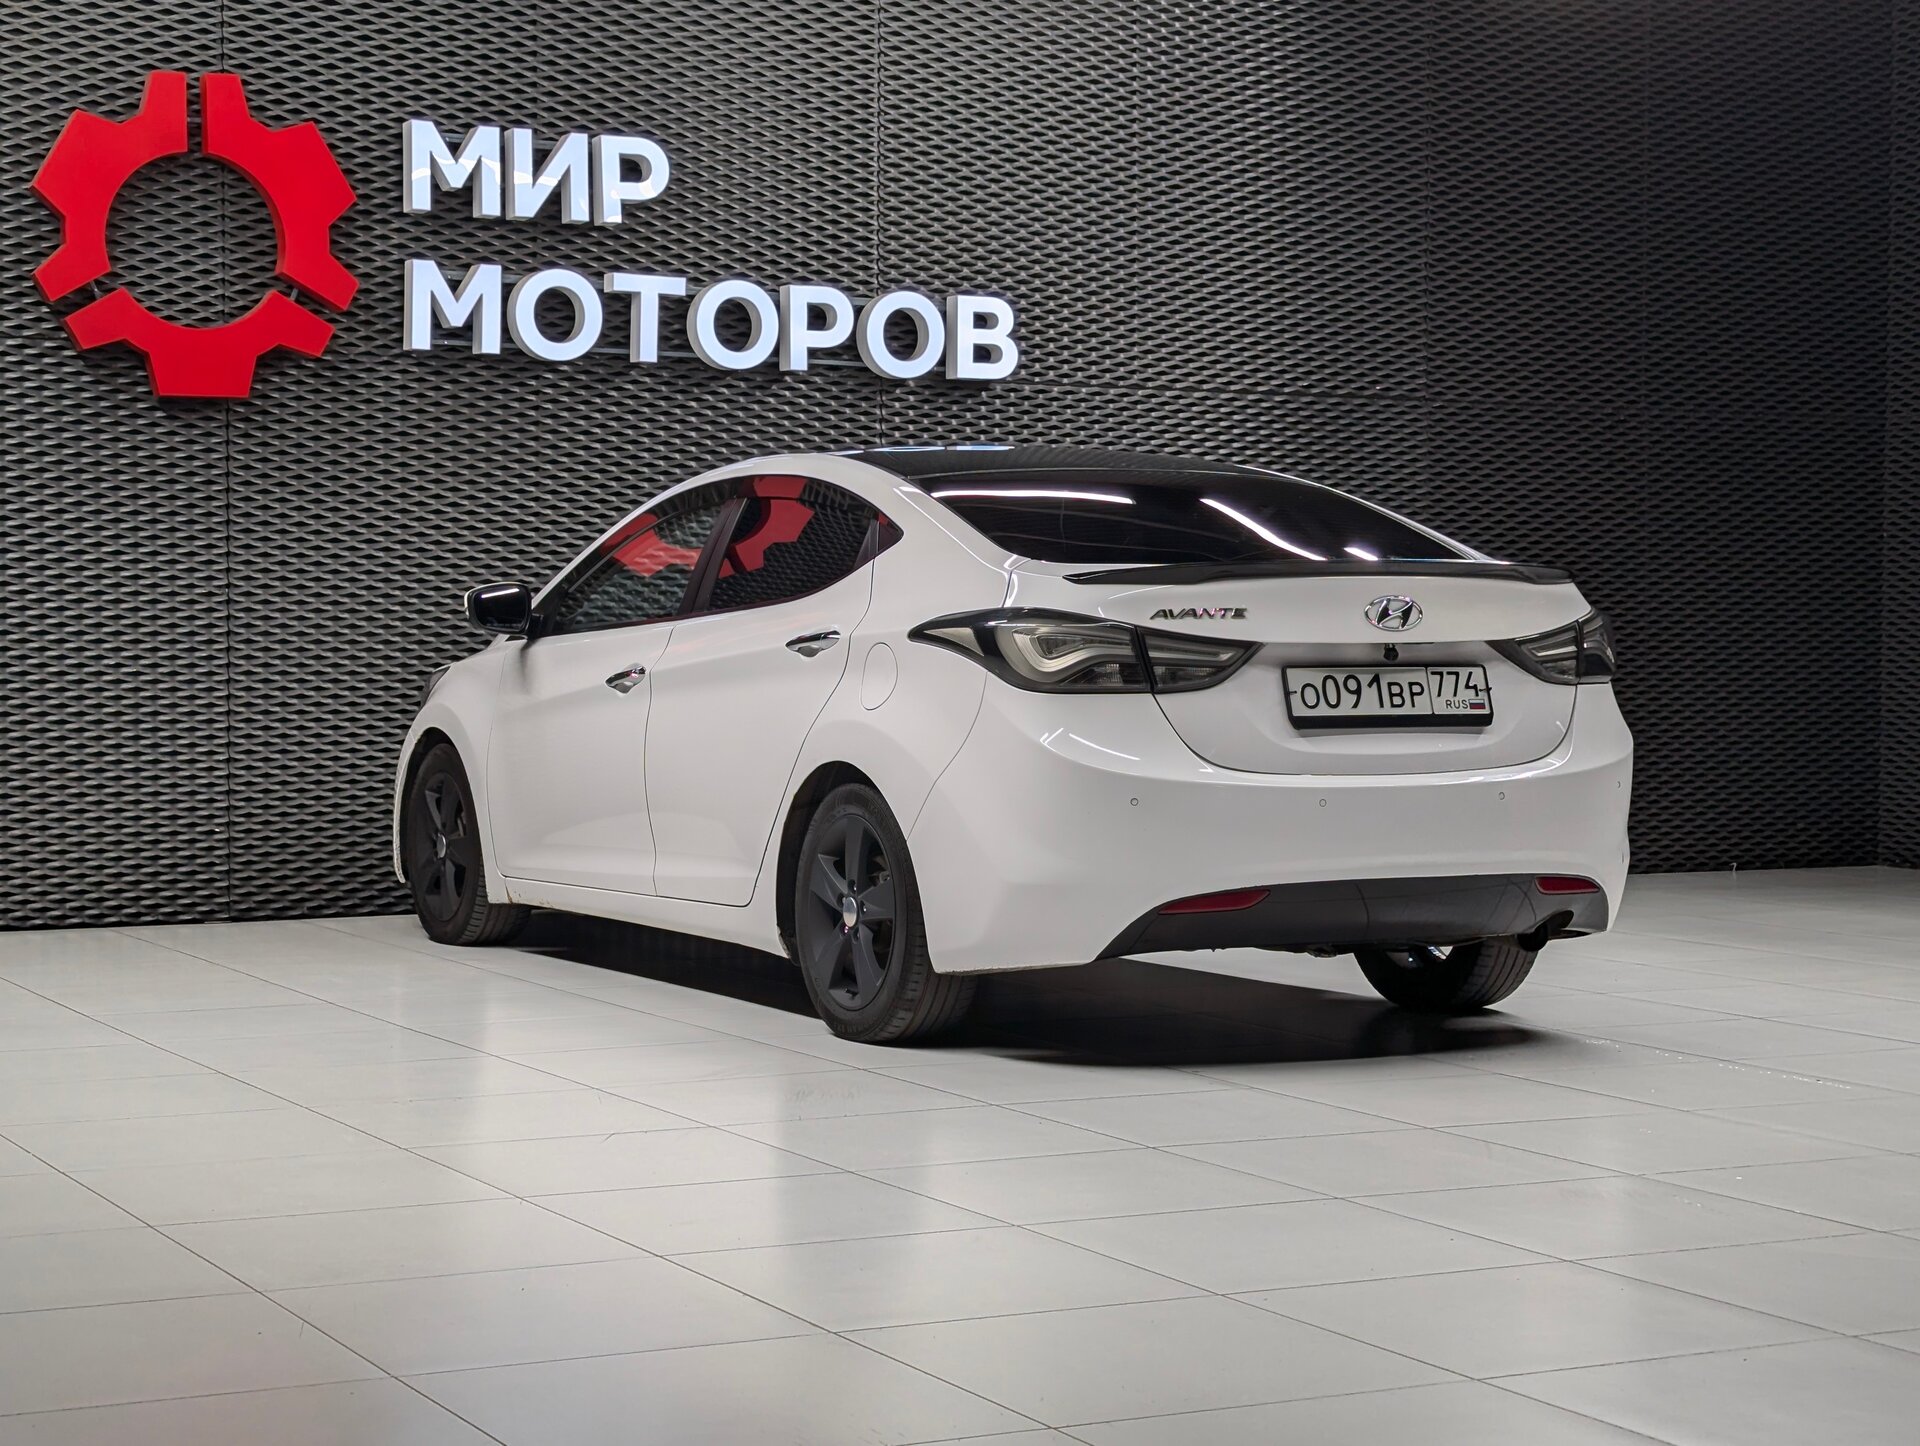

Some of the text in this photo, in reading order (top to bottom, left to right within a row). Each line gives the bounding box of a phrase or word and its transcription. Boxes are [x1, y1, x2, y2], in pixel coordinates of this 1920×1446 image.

[402, 119, 671, 226] МИР
[402, 258, 1020, 381] МОТОРОВ
[1150, 607, 1248, 620] AVANTE
[1430, 671, 1480, 698] 774
[1445, 699, 1469, 709] RUS
